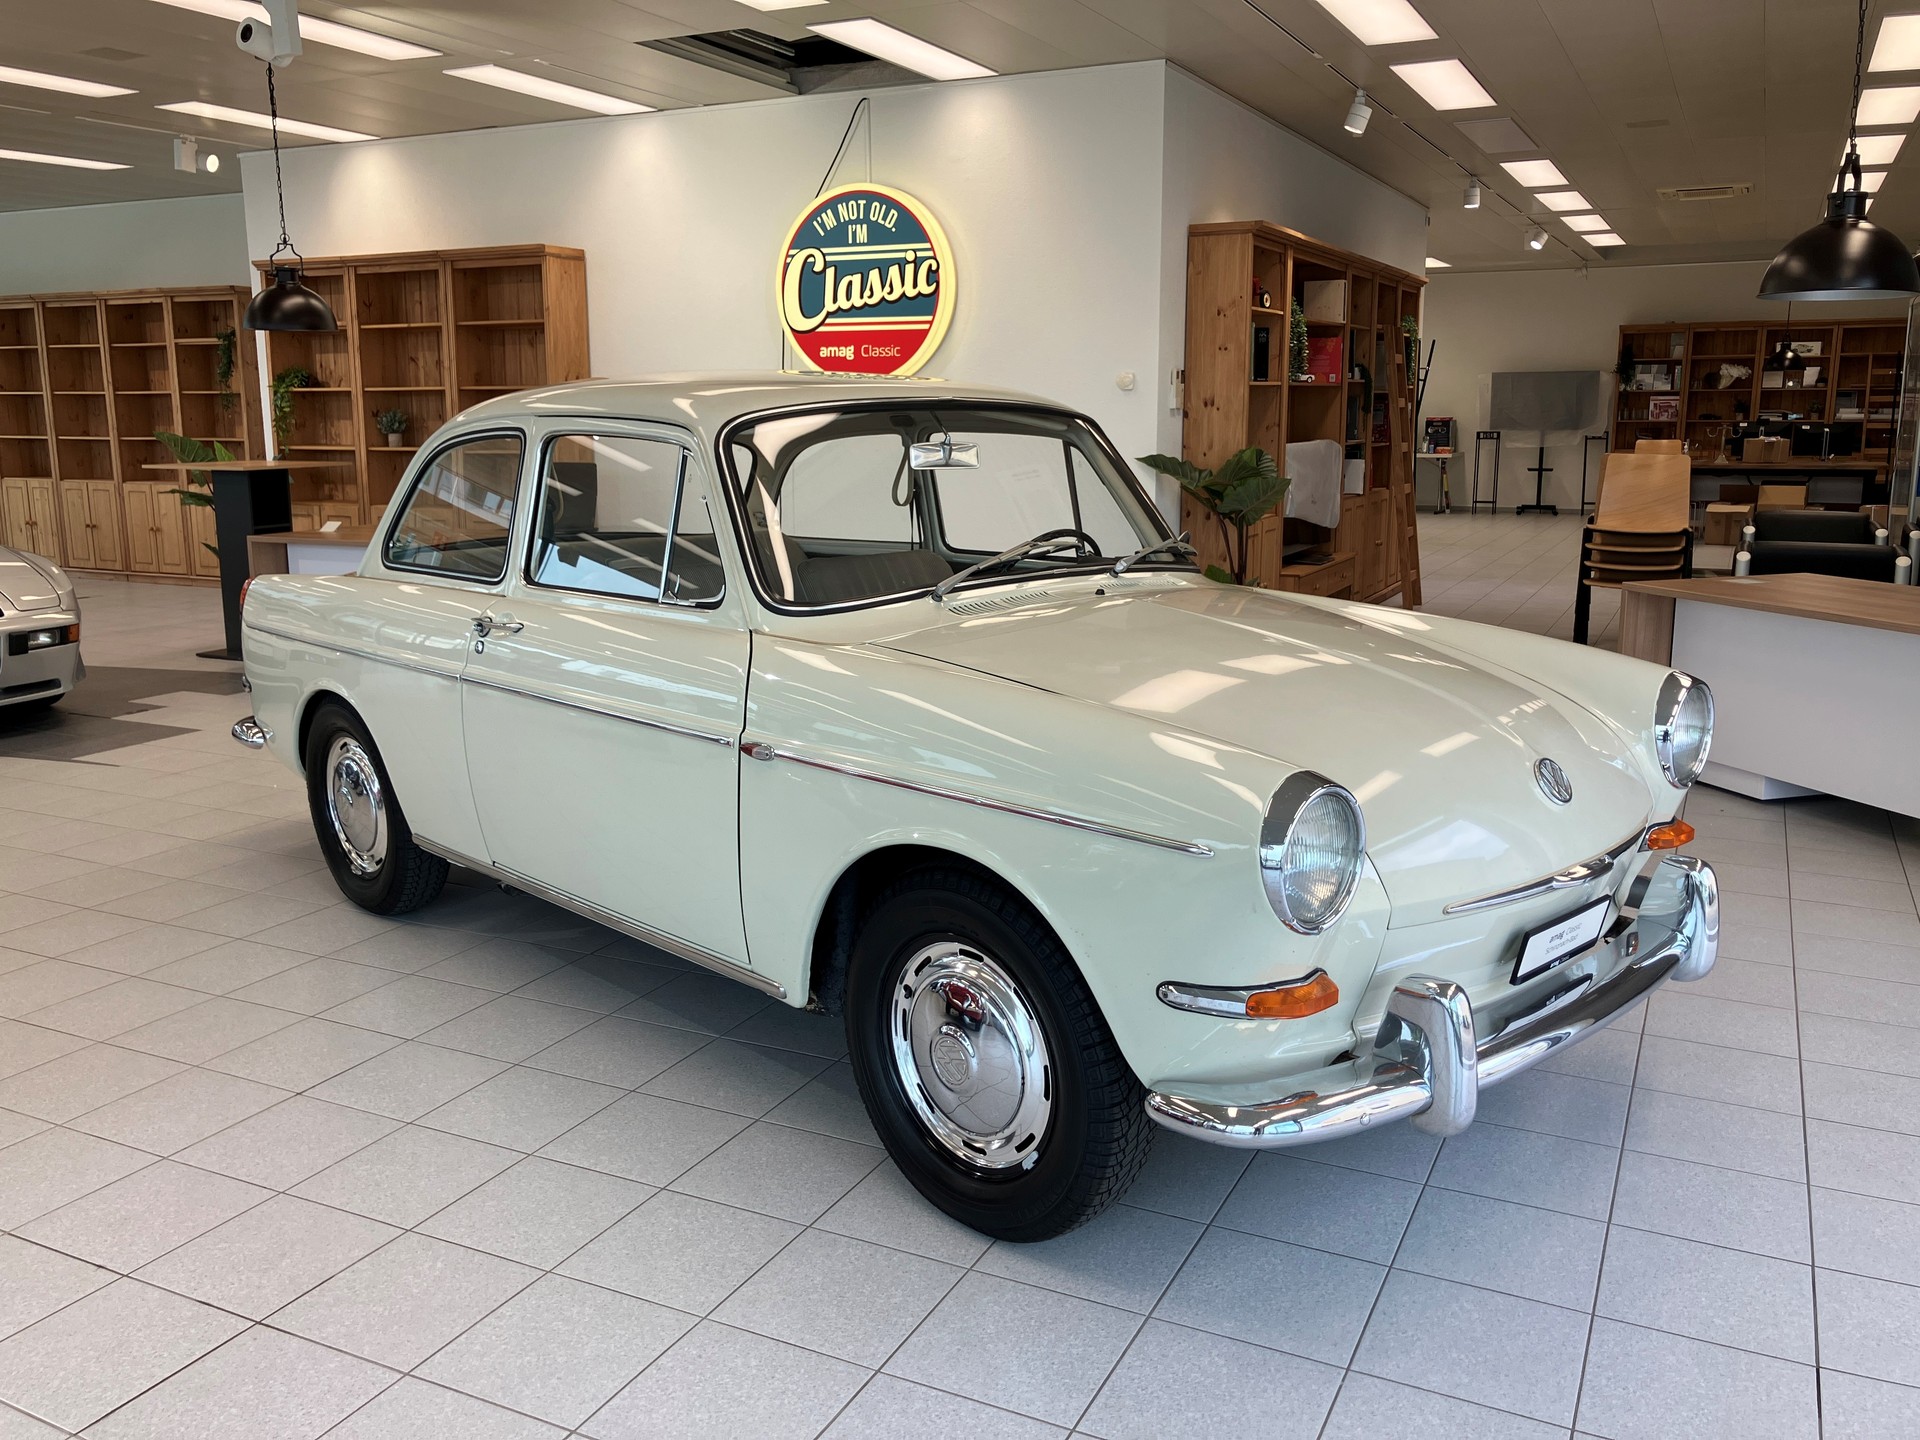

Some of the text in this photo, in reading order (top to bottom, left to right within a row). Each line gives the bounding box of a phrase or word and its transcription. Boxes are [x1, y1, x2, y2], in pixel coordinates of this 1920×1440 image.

[813, 200, 899, 236] I'M NOT OLD.
[848, 224, 868, 243] I'M
[783, 247, 940, 333] Classic
[819, 344, 901, 360] amag Classic
